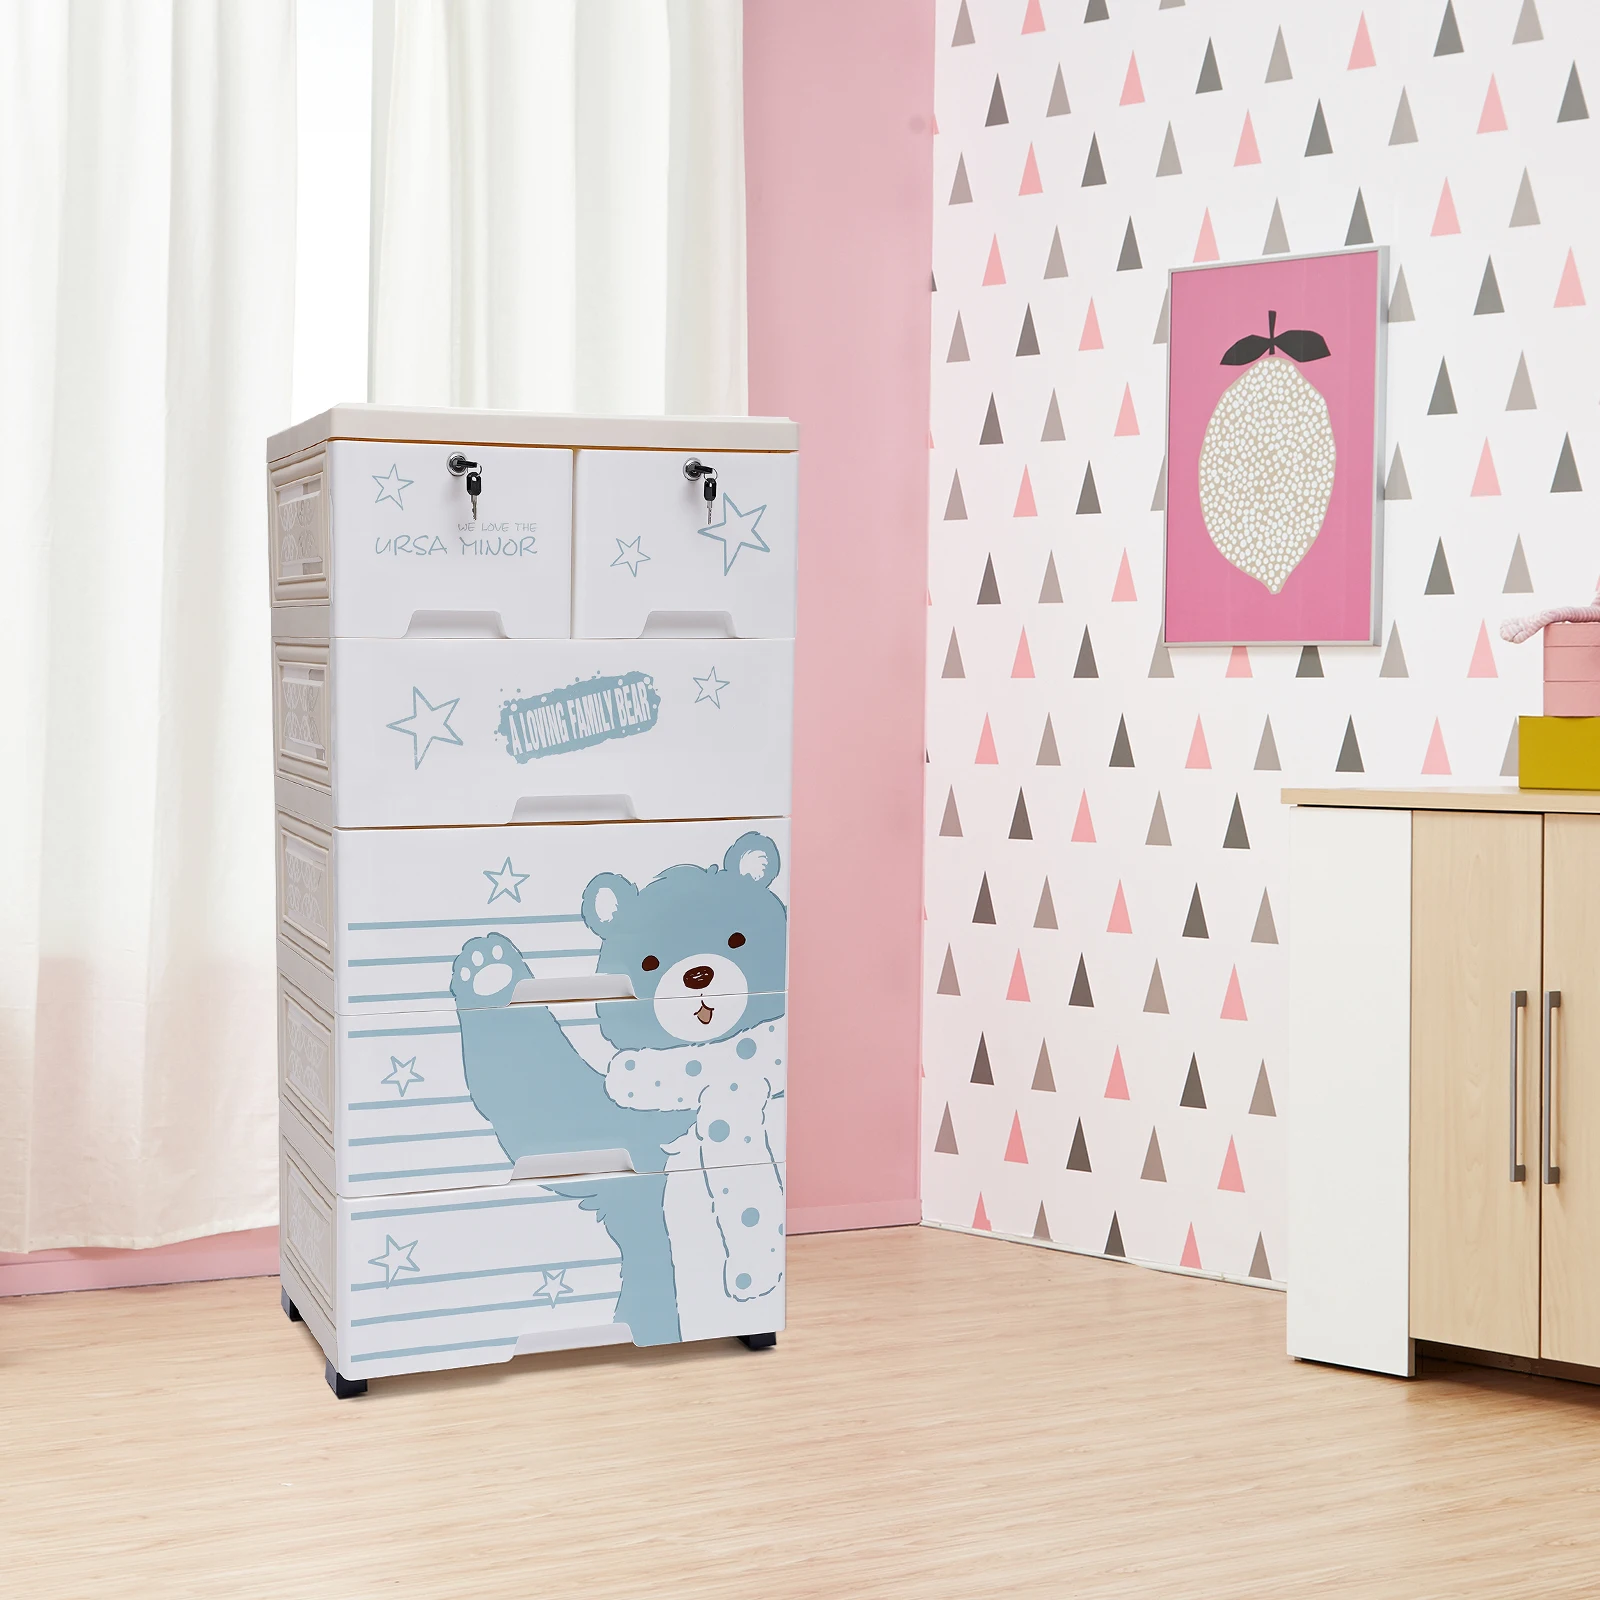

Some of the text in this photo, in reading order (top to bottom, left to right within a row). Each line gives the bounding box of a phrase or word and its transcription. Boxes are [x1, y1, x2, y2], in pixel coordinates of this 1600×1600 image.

[457, 522, 538, 532] WE LOVE THE
[375, 534, 538, 557] URSA MINOR
[508, 681, 652, 756] A LOVING FAMILY BEAR
